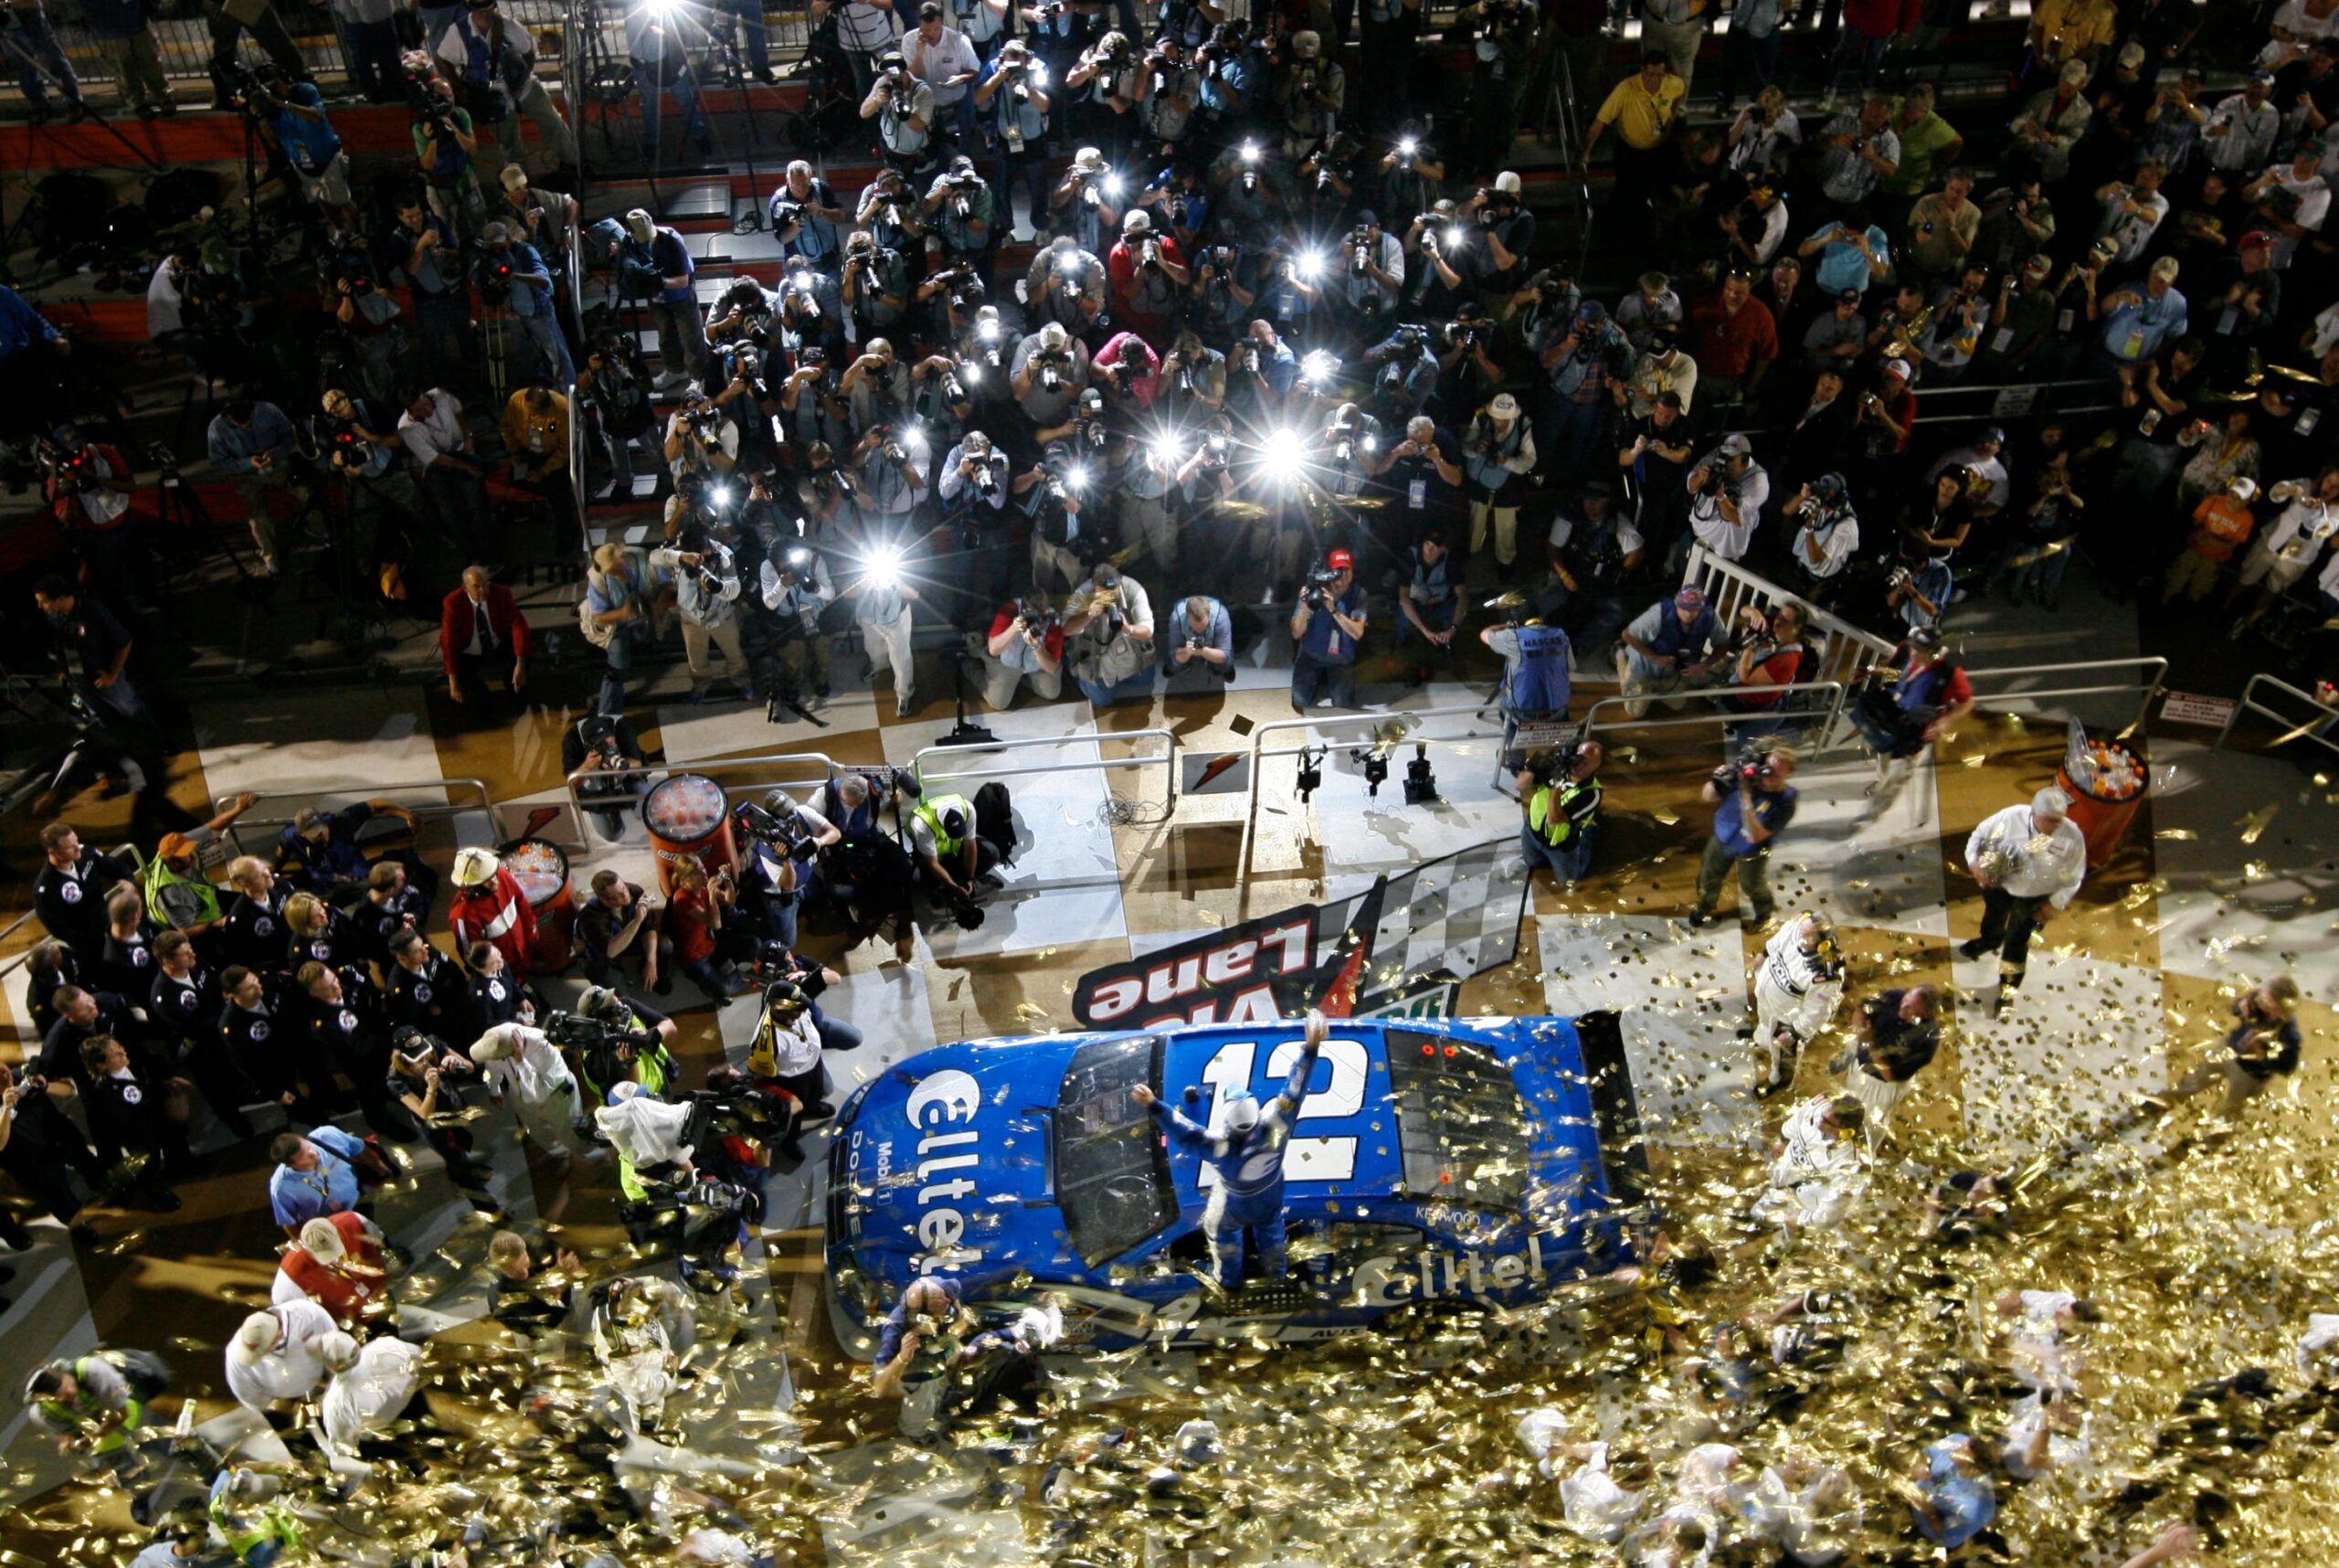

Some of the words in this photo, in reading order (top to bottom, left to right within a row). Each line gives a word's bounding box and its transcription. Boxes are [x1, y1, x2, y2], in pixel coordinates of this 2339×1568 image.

[1088, 918, 1311, 1022] Lane
[877, 1140, 893, 1187] Mobil
[1197, 1039, 1369, 1188] 12
